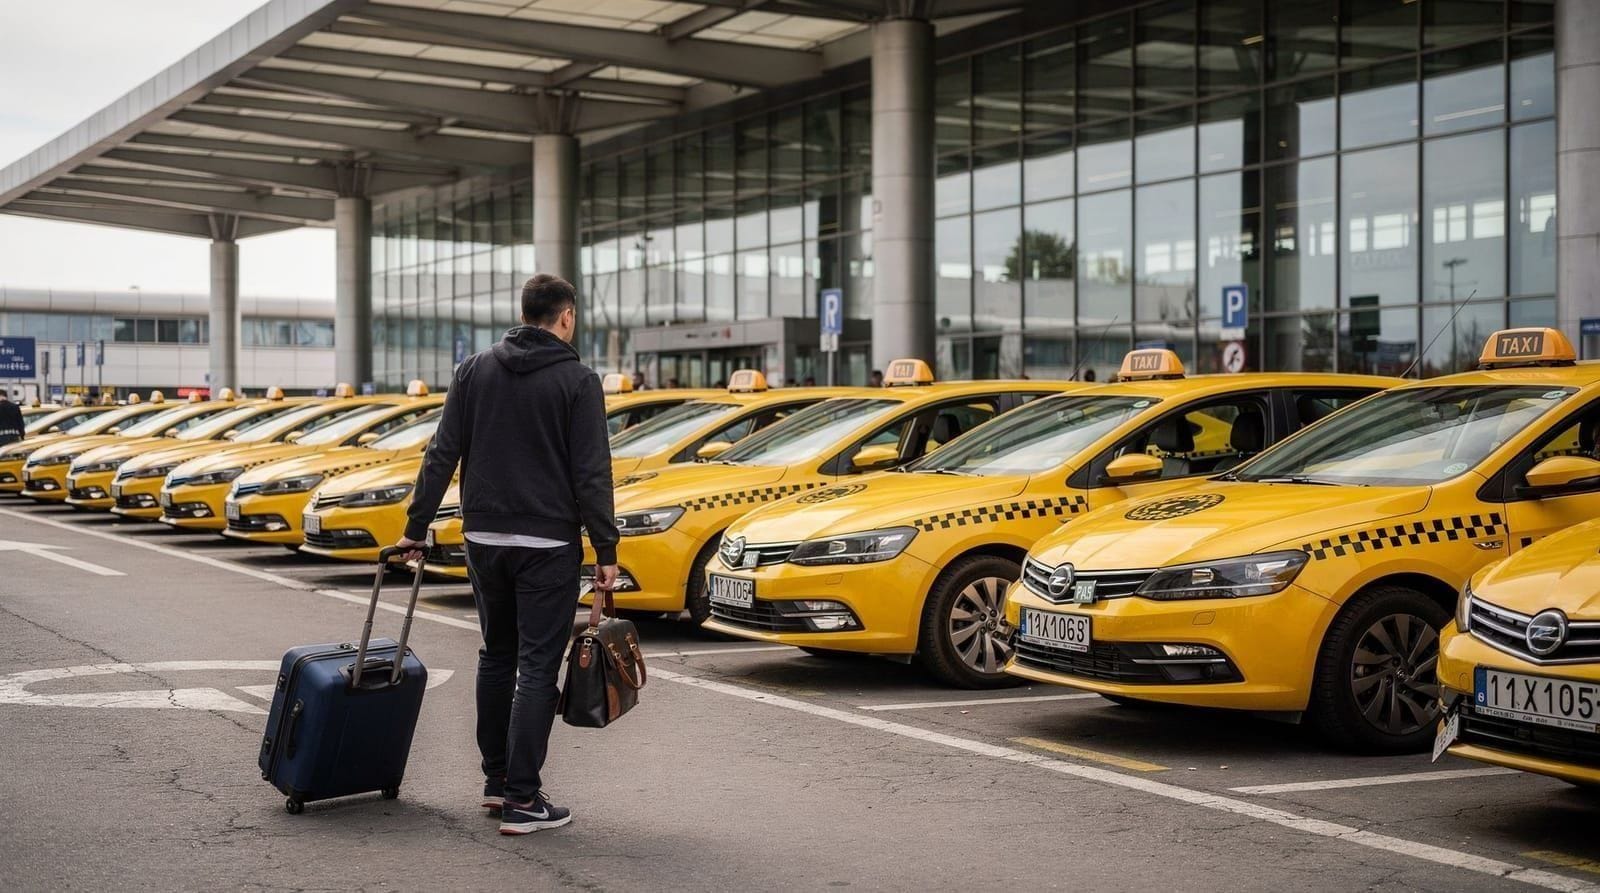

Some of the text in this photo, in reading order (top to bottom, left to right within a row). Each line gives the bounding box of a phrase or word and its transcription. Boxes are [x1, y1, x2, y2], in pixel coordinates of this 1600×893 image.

[1227, 290, 1244, 323] P
[1502, 336, 1539, 354] TAXI
[1132, 354, 1158, 369] TAXI
